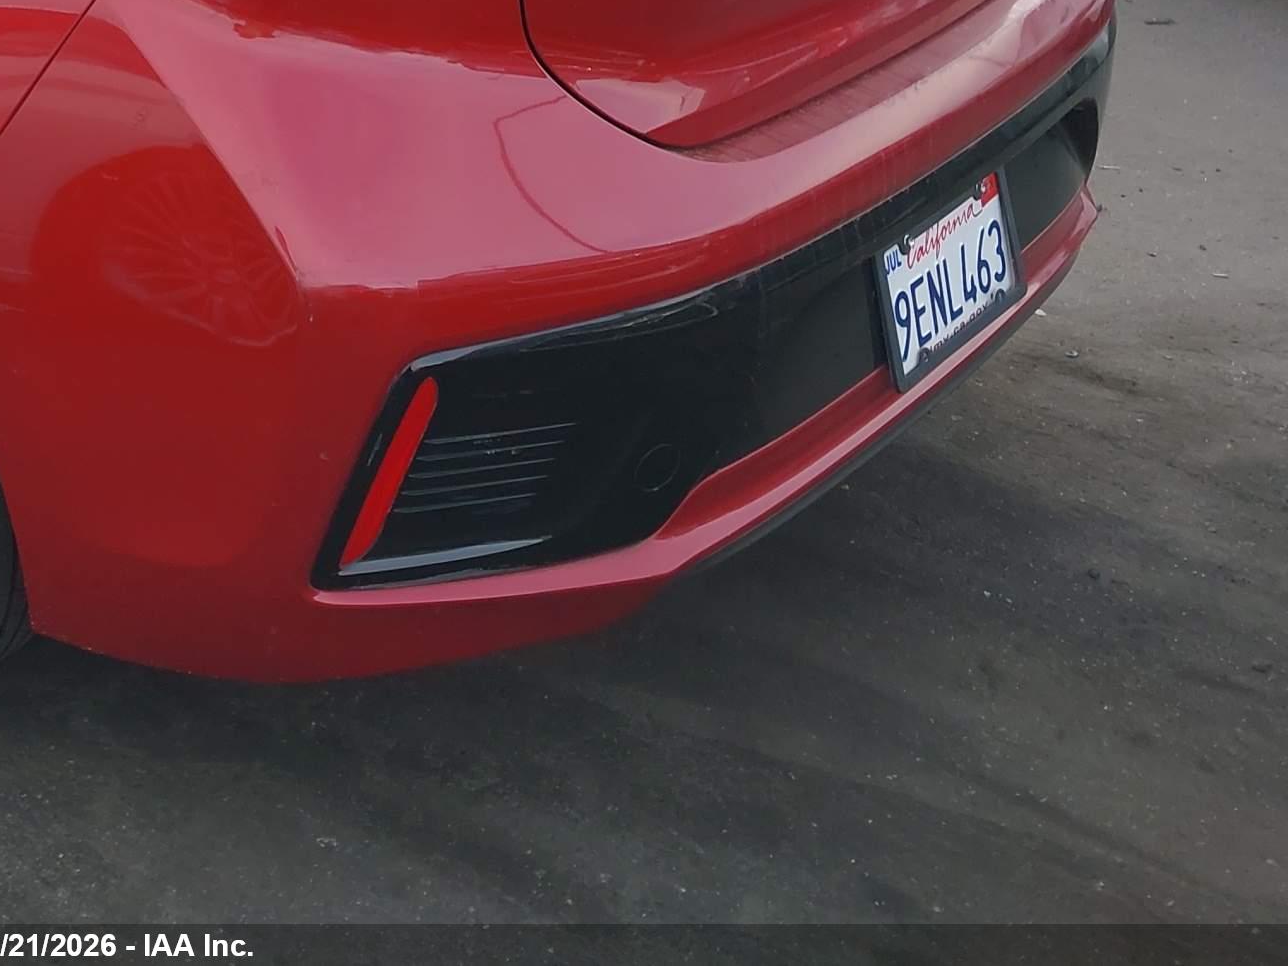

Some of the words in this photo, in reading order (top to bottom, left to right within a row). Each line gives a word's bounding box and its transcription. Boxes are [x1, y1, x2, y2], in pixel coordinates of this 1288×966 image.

[885, 248, 902, 274] JUL
[907, 201, 983, 270] California
[894, 219, 1007, 363] 9ENL463
